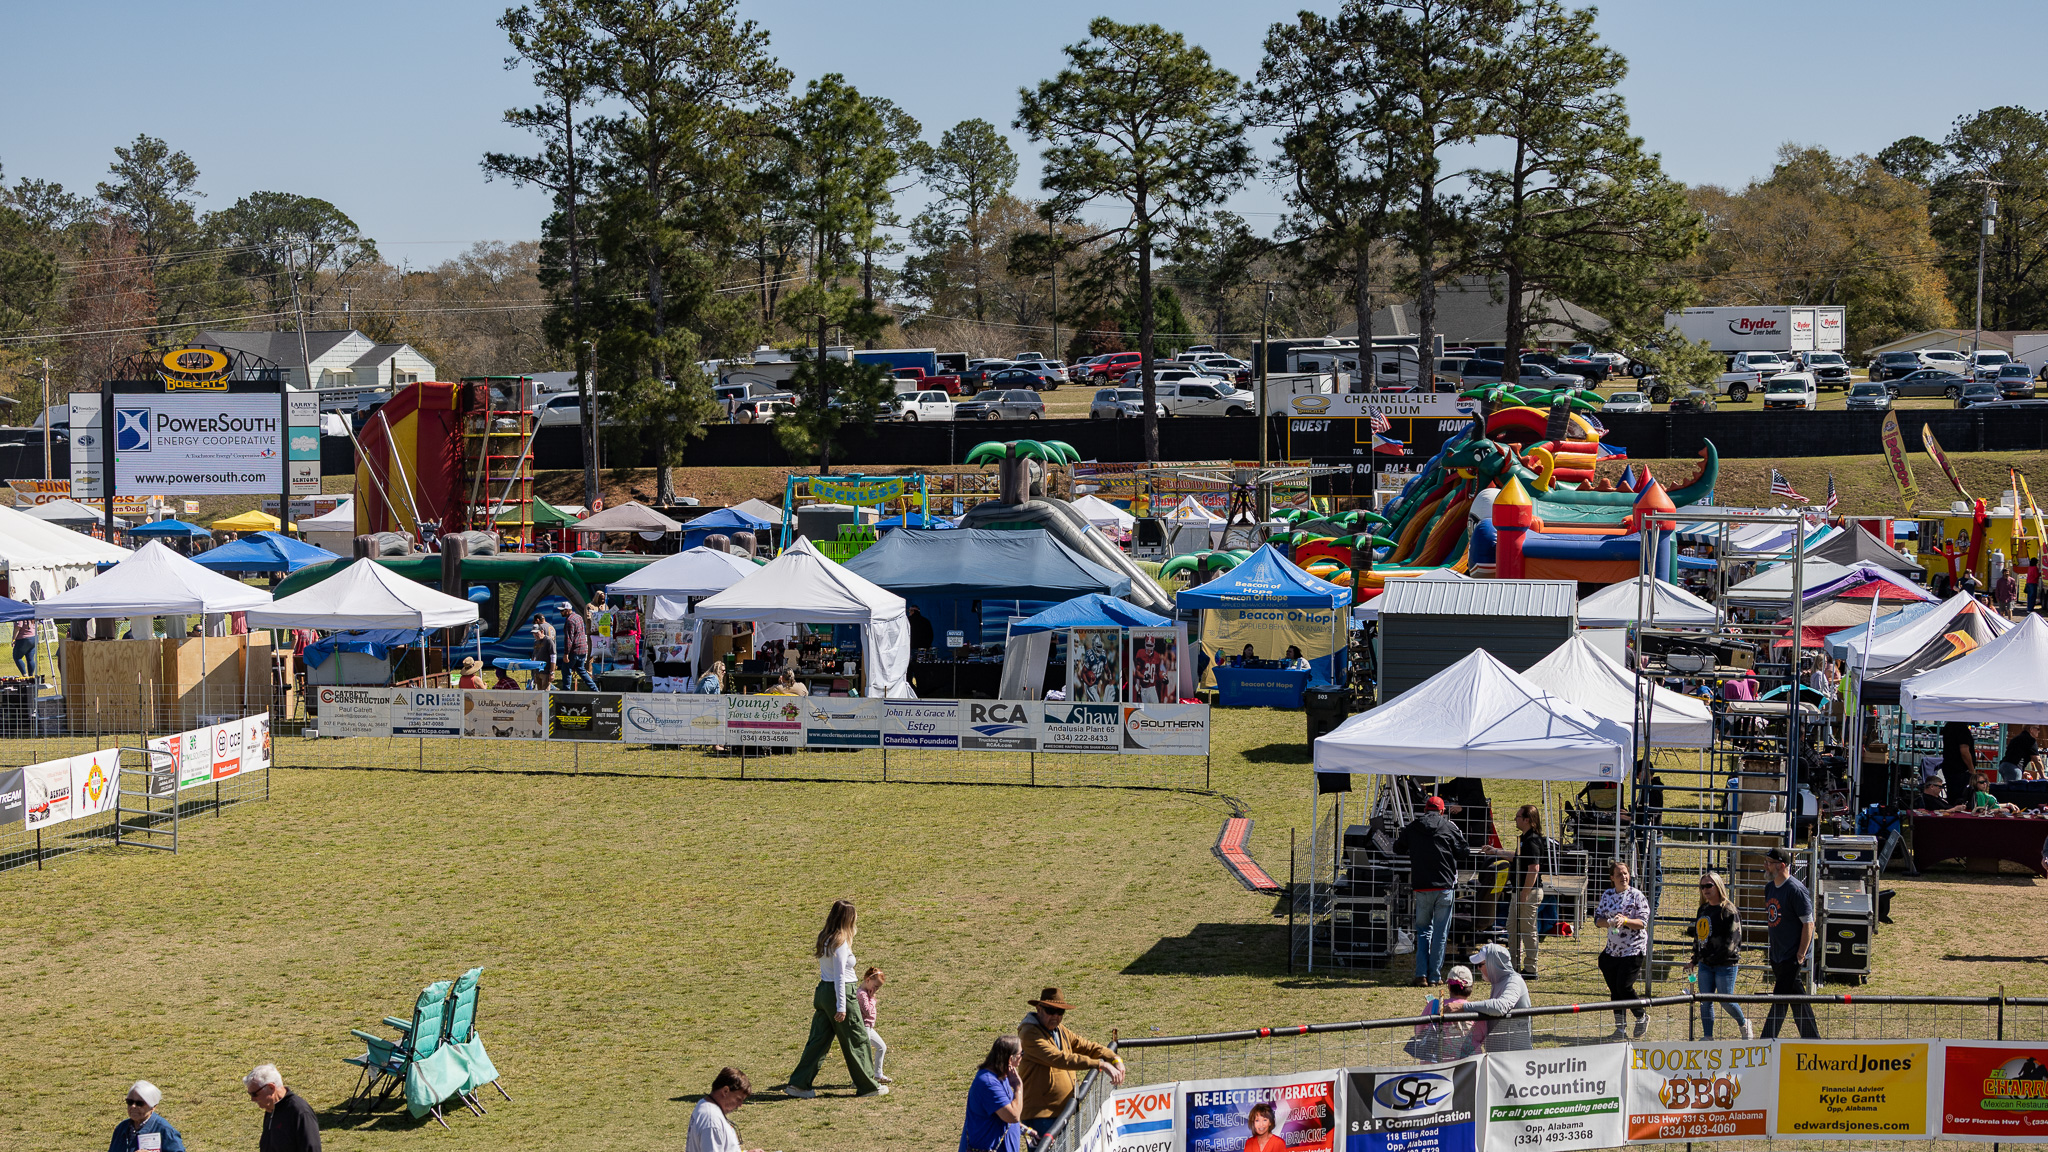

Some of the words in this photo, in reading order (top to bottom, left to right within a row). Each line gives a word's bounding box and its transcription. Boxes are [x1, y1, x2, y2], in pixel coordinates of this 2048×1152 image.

[1740, 318, 1777, 331] Ryder
[1797, 322, 1810, 331] Ryder
[1825, 319, 1838, 327] Ryder
[1753, 329, 1765, 337] Ever
[166, 379, 228, 390] BOBCATS
[1344, 395, 1438, 405] CHANNELL-LEE
[1361, 405, 1420, 415] SADIUM
[1291, 420, 1331, 432] GUEST
[157, 436, 199, 447] ENERGY
[202, 435, 276, 446] COOPERATIVE
[1886, 437, 1910, 489] NACHOS
[1095, 467, 1133, 475] ONION
[1357, 463, 1371, 477] GO
[135, 472, 266, 485] www.powersouth.com
[1099, 478, 1149, 487] FRIES
[813, 483, 899, 502] RECKLESS
[1202, 495, 1227, 507] Cake
[125, 505, 144, 514] Dogs
[1235, 581, 1269, 589] Beacon
[1220, 595, 1252, 603] Beacon
[1253, 595, 1265, 603] Of
[1266, 595, 1288, 605] Hope
[1239, 611, 1284, 621] Beacon
[1287, 611, 1303, 621] Of
[1306, 613, 1338, 625] Hope
[1073, 628, 1119, 636] AUTOGRAPHS
[1239, 623, 1267, 631] APPLIED
[1269, 624, 1305, 632] BEHAVIOR
[1306, 625, 1338, 633] ANALYSIS
[1134, 631, 1175, 639] AUTOGRAPHS
[334, 690, 369, 698] CATRETT
[334, 697, 390, 705] CONSTRUCTION
[416, 694, 440, 707] CRI
[478, 700, 500, 708] Walker
[501, 700, 531, 711] Veterinary
[728, 696, 779, 711] Young's
[354, 706, 373, 714] Catrett
[884, 709, 903, 718] John
[905, 709, 913, 717] H.
[923, 710, 945, 718] Grace
[970, 703, 1029, 724] RCA
[1072, 707, 1118, 725] Shaw
[655, 717, 683, 726] Engineers
[728, 711, 753, 719] Florist
[762, 711, 779, 722] Gifts
[907, 721, 936, 734] Estep
[1048, 725, 1083, 733] Andalusia
[1140, 720, 1204, 728] SOUTHERN
[740, 735, 757, 743] (334)
[885, 736, 919, 744] Charitable
[920, 737, 957, 746] Foundation
[1054, 734, 1072, 742] (334)
[1630, 1048, 1723, 1071] HOOK'S
[1729, 1044, 1772, 1069] PIT
[1525, 1058, 1587, 1079] Spurlin
[1988, 1069, 2008, 1079] EL
[1194, 1091, 1247, 1107] RE-ELECT
[1247, 1088, 1284, 1104] BECKY
[1285, 1083, 1328, 1100] BRACKE
[1504, 1078, 1607, 1100] Accounting
[1667, 1077, 1735, 1110] BBQ
[1819, 1094, 1848, 1106] Kyle
[1851, 1094, 1887, 1104] Gantt
[1983, 1100, 2014, 1109] Mexican
[2015, 1100, 2048, 1109] Restaura
[1115, 1093, 1172, 1120] EXXON
[1491, 1109, 1507, 1119] For
[1508, 1109, 1521, 1118] all
[1522, 1108, 1543, 1119] your
[1543, 1104, 1592, 1116] accounting
[1591, 1101, 1620, 1112] needs
[1827, 1106, 1844, 1114] Opp,
[1845, 1105, 1878, 1113] Alabama
[1195, 1112, 1246, 1129] RE-ELECT
[1352, 1121, 1360, 1131] S
[1362, 1120, 1372, 1131] &
[1375, 1119, 1383, 1130] P
[1386, 1111, 1471, 1130] Communication
[1631, 1115, 1646, 1124] 601
[1647, 1115, 1660, 1124] US
[1662, 1115, 1681, 1126] Hwy
[1682, 1114, 1697, 1123] 331
[1699, 1114, 1708, 1124] S,
[1709, 1114, 1727, 1123] Opp,
[1729, 1111, 1764, 1121] Alabama
[2001, 1119, 2020, 1127] Hwy
[1525, 1124, 1545, 1134] Opp,
[1547, 1121, 1584, 1131] Alabama
[1659, 1125, 1686, 1139] (334)
[1688, 1122, 1737, 1134] 493-4060
[1793, 1121, 1911, 1133] edwardsjones.com
[1195, 1136, 1246, 1152] RE-ELECT
[1286, 1128, 1327, 1146] BRACKE
[1386, 1132, 1399, 1142] 118
[1401, 1131, 1419, 1140] Ellis
[1419, 1128, 1439, 1138] Road
[1514, 1134, 1543, 1147] (334)
[1545, 1130, 1593, 1143] 493-3368
[1386, 1142, 1406, 1152] Opp,
[1406, 1138, 1439, 1149] Alabama
